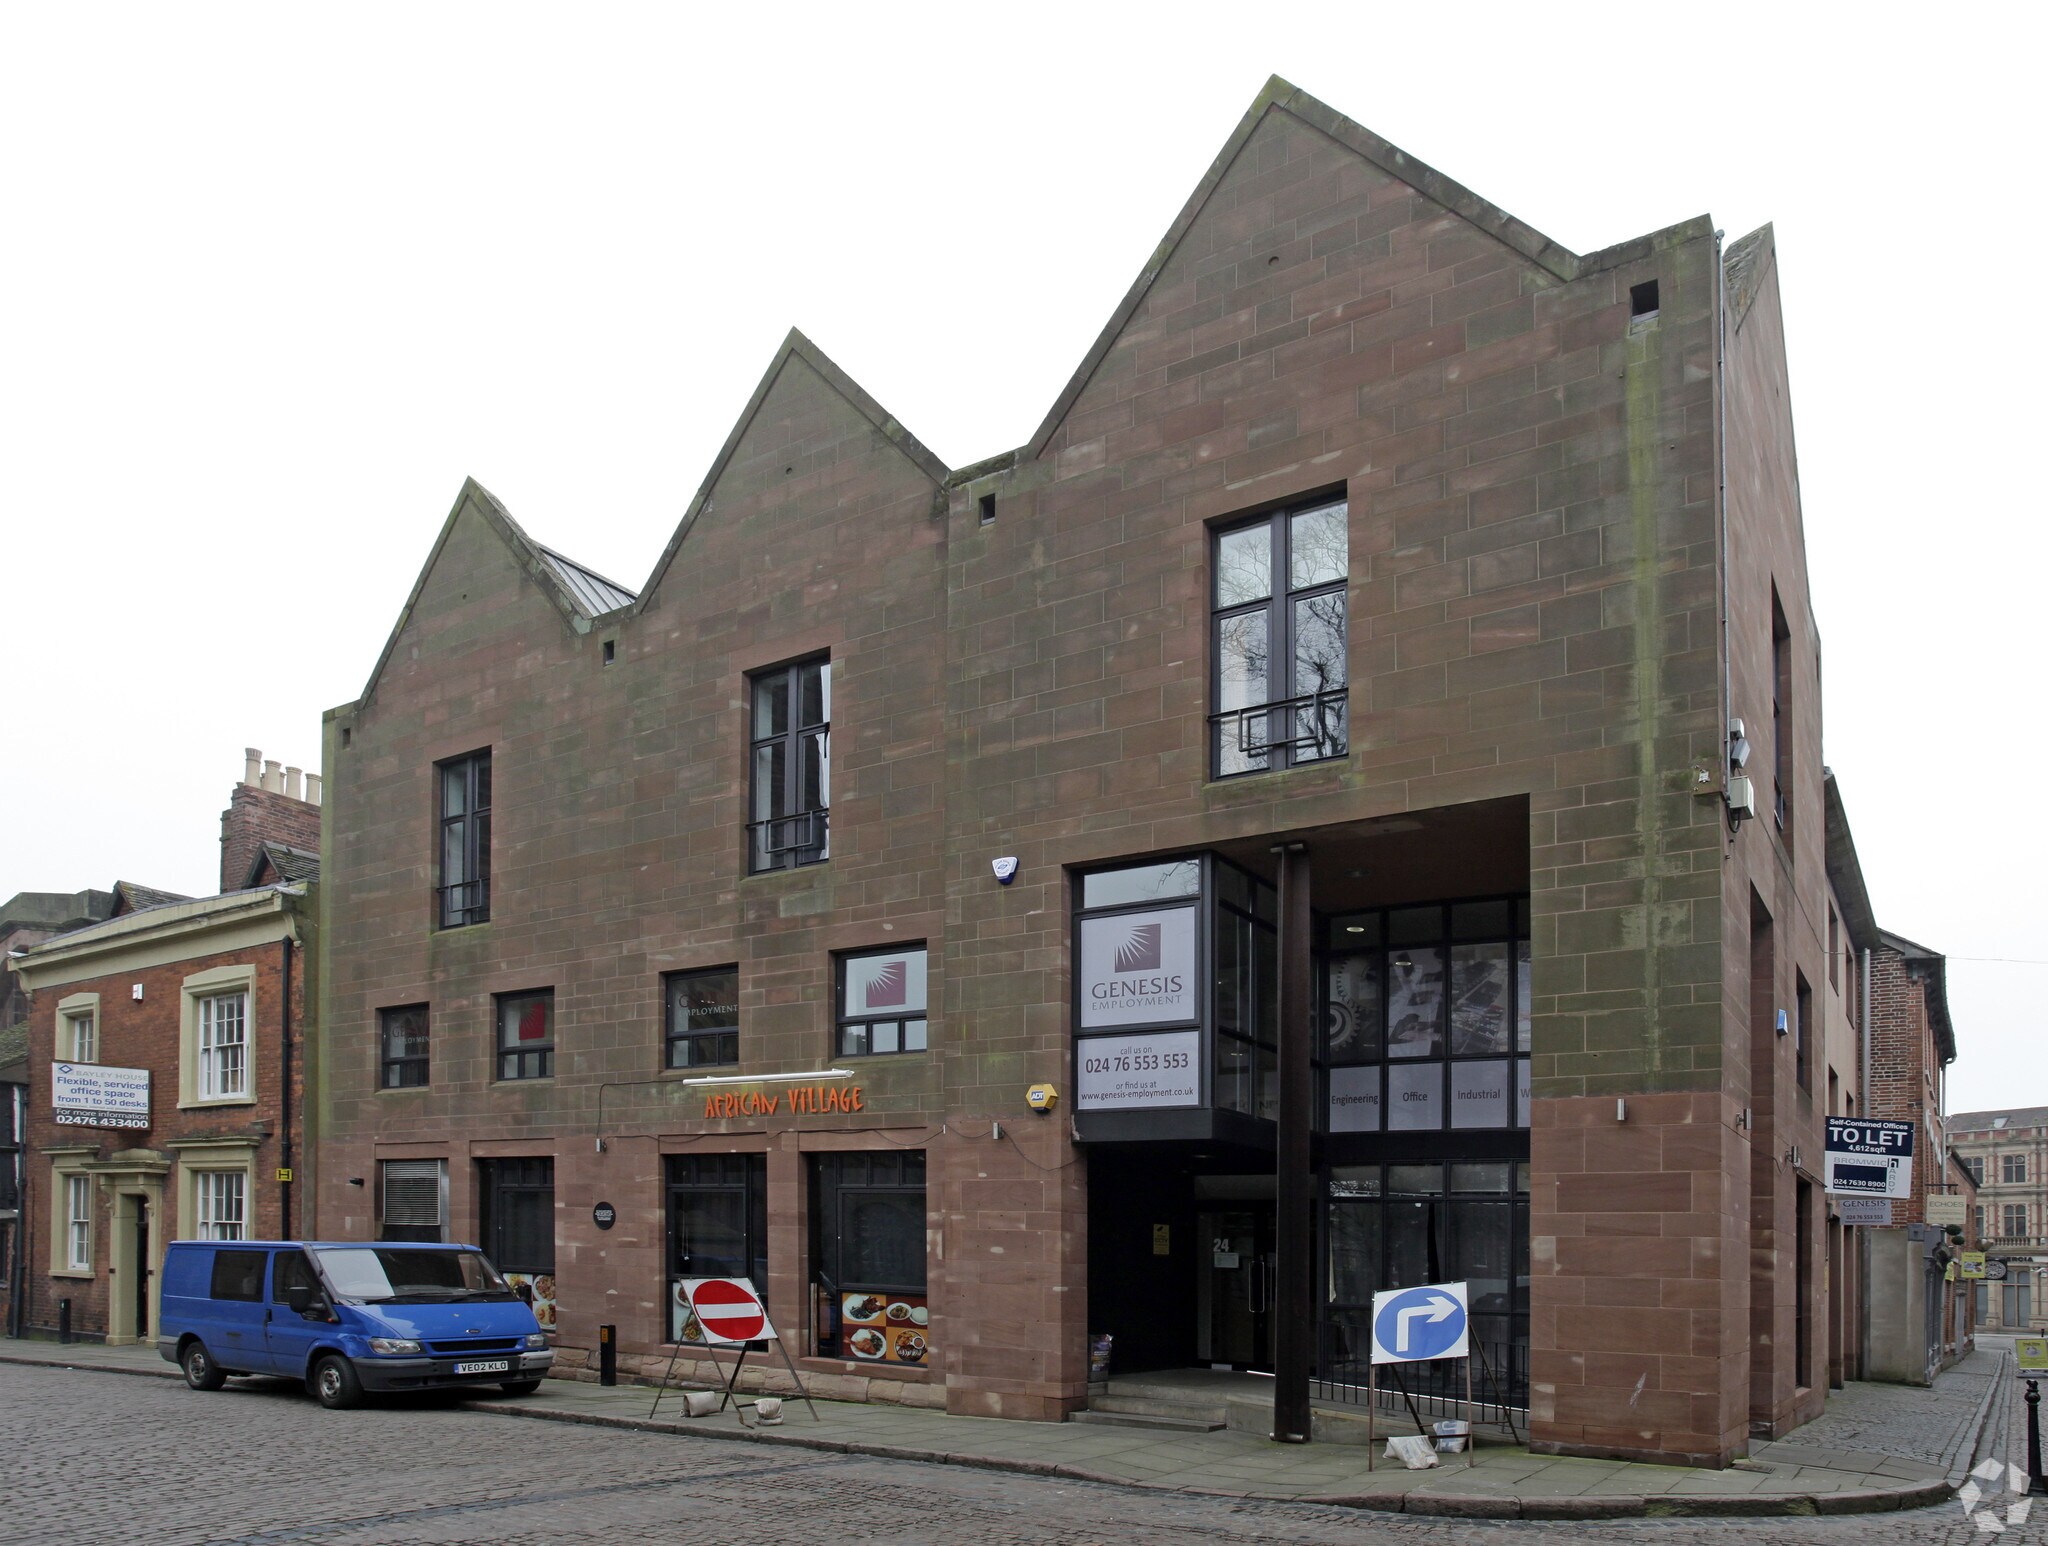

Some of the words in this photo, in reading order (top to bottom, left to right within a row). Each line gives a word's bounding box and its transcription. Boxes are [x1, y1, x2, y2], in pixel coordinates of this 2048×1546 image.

[1091, 975, 1183, 999] GENESIS
[1092, 995, 1182, 1011] EMPLOYMENT
[680, 1004, 738, 1017] MPLOYMENT
[1120, 1046, 1132, 1055] call
[1085, 1058, 1110, 1073] 024
[1114, 1056, 1130, 1072] 76
[1134, 1055, 1159, 1070] 553
[1163, 1053, 1189, 1069] 553
[76, 1070, 113, 1078] BAYLEY
[115, 1072, 149, 1081] HOUSE
[57, 1076, 102, 1088] Flexible,
[104, 1081, 148, 1090] serviced
[1125, 1081, 1139, 1089] find
[70, 1087, 101, 1096] office
[104, 1090, 136, 1098] space
[1031, 1091, 1044, 1100] ADT
[1081, 1087, 1194, 1101] www.genesis-employment.co.uk
[1402, 1091, 1428, 1102] Office
[1457, 1088, 1501, 1100] Industrial
[57, 1095, 81, 1103] from
[119, 1099, 148, 1108] desks
[1331, 1093, 1379, 1106] Engineering
[56, 1115, 98, 1125] 02476
[100, 1118, 149, 1128] 433400
[98, 1111, 149, 1120] information
[1829, 1118, 1882, 1129] Self-Contained
[1883, 1122, 1909, 1130] Offices
[1829, 1126, 1860, 1143] TO
[1865, 1129, 1908, 1147] LET
[278, 1169, 290, 1180] H
[1848, 1179, 1867, 1187] 7630
[1867, 1180, 1886, 1188] 8900
[1842, 1200, 1886, 1208] GENESIS
[1928, 1200, 1965, 1208] ECHOES
[1213, 1238, 1230, 1252] 24
[461, 1363, 487, 1372] VE02
[488, 1361, 507, 1370] KLO
